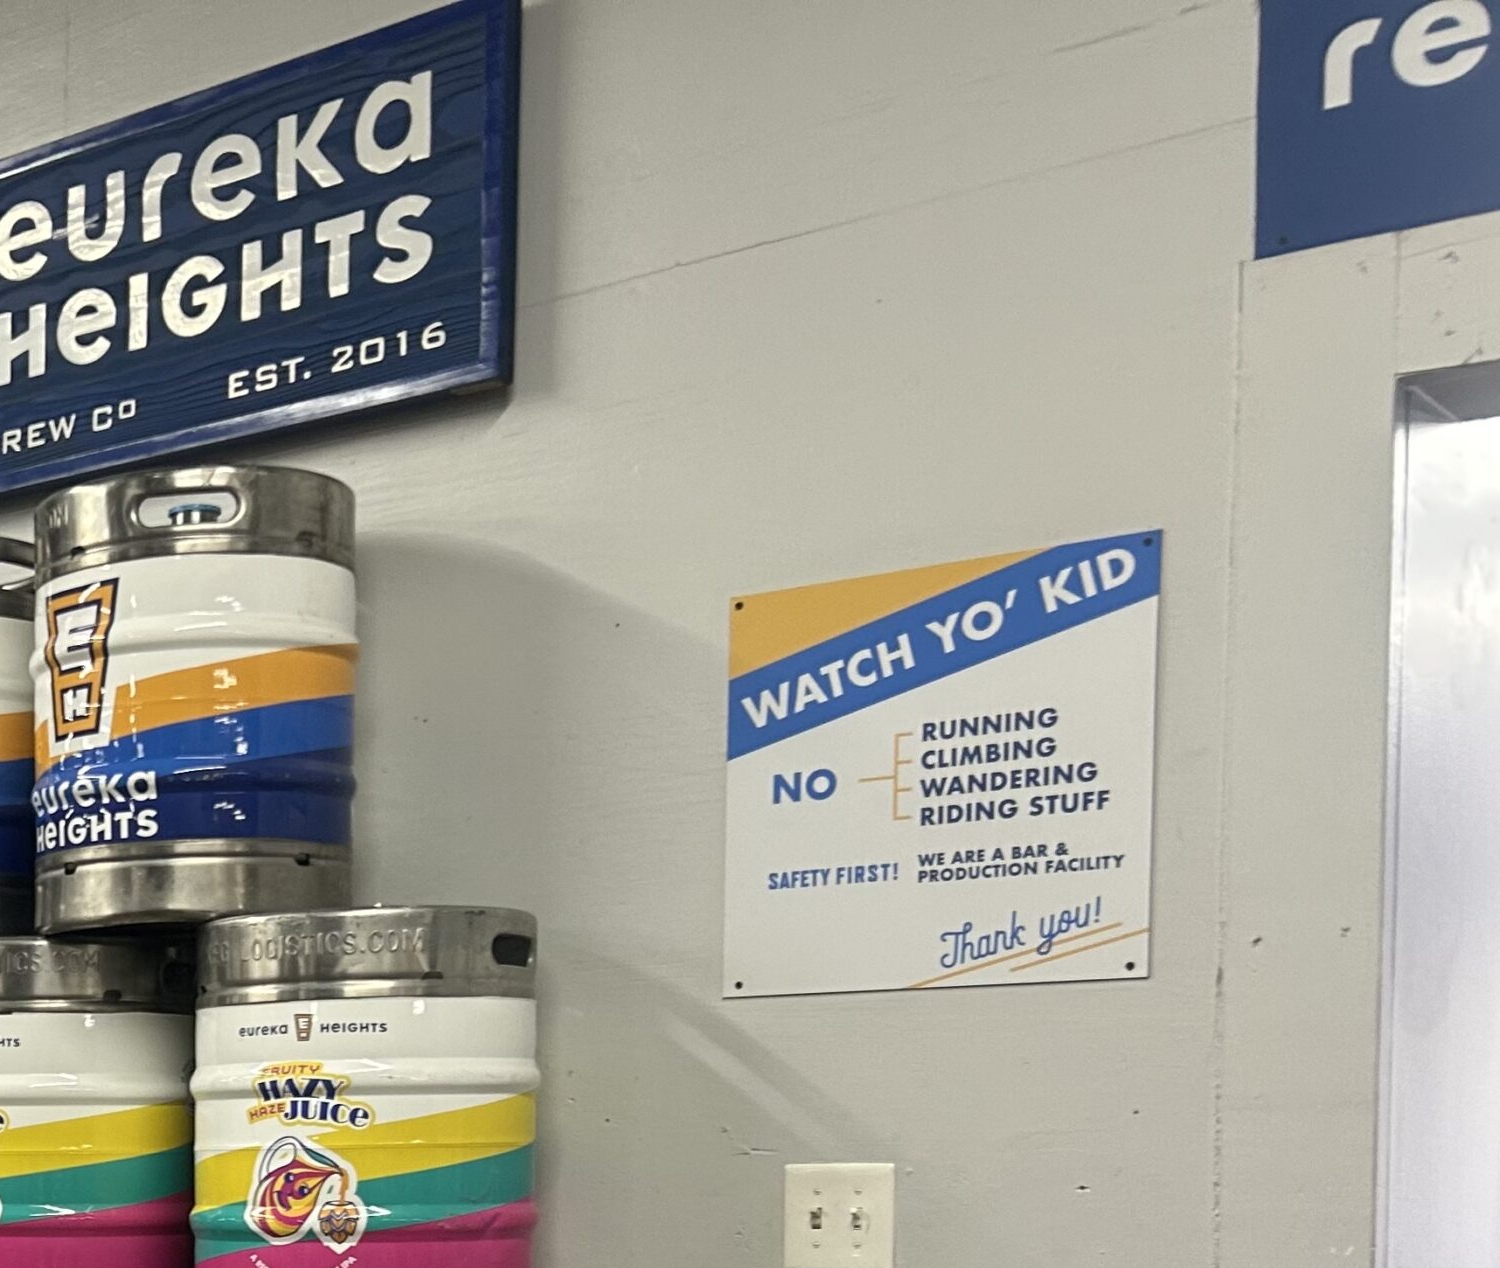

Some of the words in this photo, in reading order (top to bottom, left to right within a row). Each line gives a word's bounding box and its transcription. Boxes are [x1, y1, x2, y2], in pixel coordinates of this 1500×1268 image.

[226, 357, 313, 400] EST.
[331, 321, 447, 375] 2016
[740, 633, 915, 730] WATCH
[926, 590, 1017, 655] YO'
[1039, 547, 1136, 615] KID
[922, 707, 1059, 743] RUNNING
[921, 736, 1056, 770] CLIMBING
[772, 767, 837, 805] NO
[920, 761, 1098, 798] WANDERING
[920, 799, 1018, 827] RIDING
[1029, 790, 1110, 816] STUFF
[918, 853, 945, 867] WE
[951, 849, 985, 865] ARE
[992, 848, 1005, 861] A
[1012, 844, 1048, 860] BAR
[1055, 842, 1069, 856] &
[918, 862, 1038, 883] PRODUCTION
[1045, 854, 1125, 874] FACILITY
[768, 868, 831, 890] SAFETY
[836, 862, 899, 887] FIRST!
[940, 911, 1026, 968] Thank
[1036, 896, 1101, 956] you!
[238, 1023, 289, 1038] eureka
[260, 1064, 321, 1075] FRUITY
[257, 1077, 345, 1102] HAZY
[249, 1102, 286, 1121] HAZE
